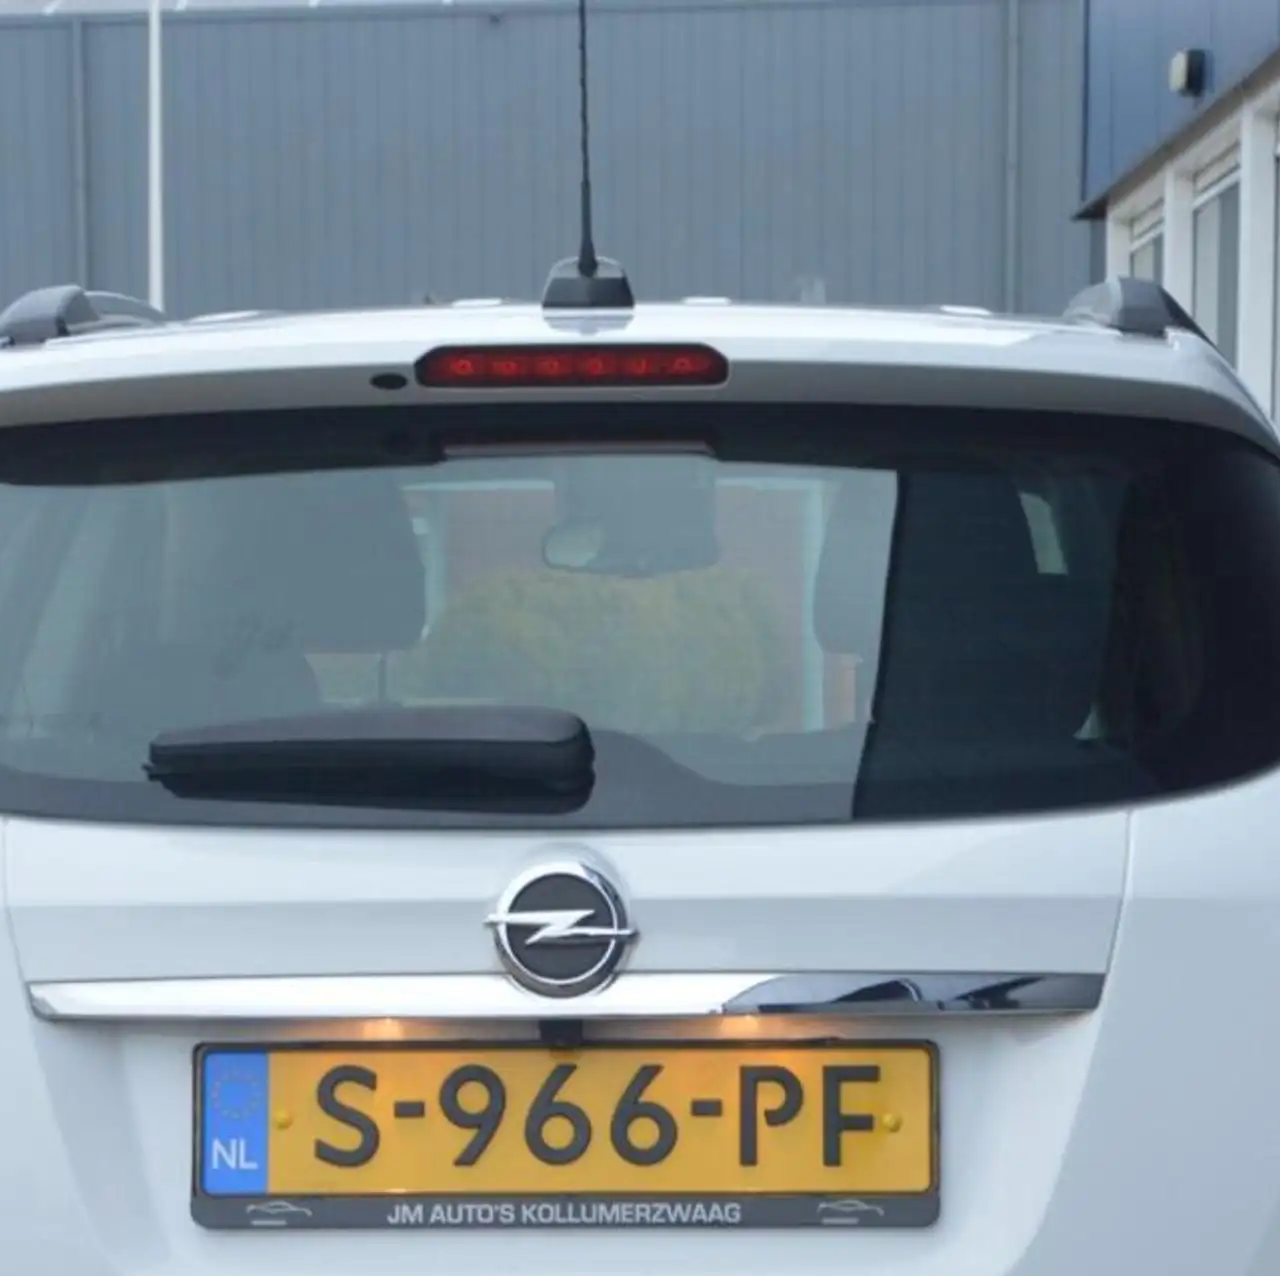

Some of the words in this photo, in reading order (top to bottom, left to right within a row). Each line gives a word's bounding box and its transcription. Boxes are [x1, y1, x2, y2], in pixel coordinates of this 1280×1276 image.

[312, 1063, 880, 1168] S-966-PF
[212, 1138, 259, 1170] NL
[387, 1203, 423, 1224] JM
[429, 1203, 515, 1224] AUTO'S
[521, 1203, 741, 1224] KOLLUMERZWAAG
